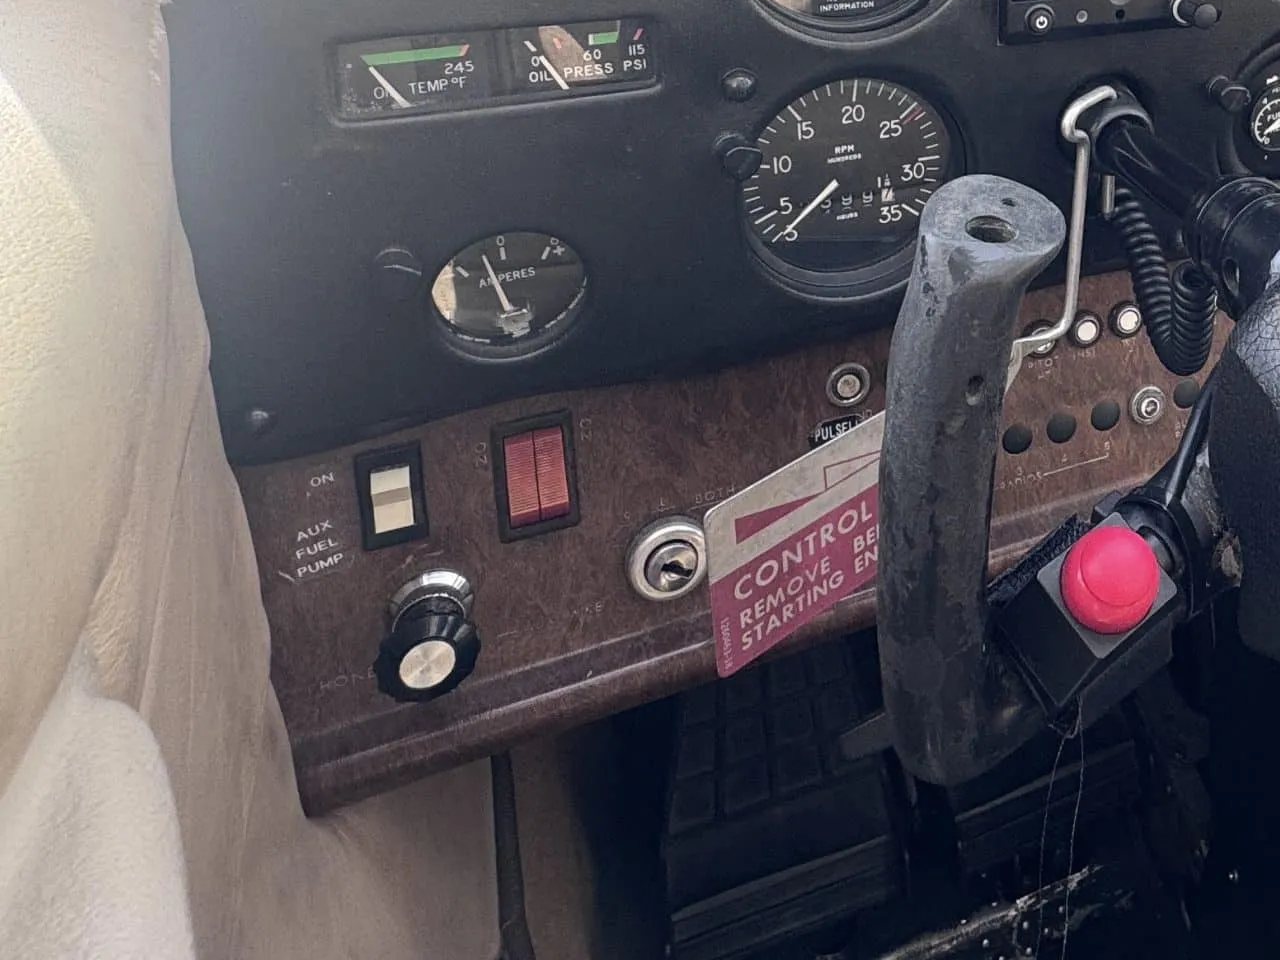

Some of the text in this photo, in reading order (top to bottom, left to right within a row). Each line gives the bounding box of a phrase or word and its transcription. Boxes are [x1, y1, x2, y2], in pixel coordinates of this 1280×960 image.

[819, 1, 875, 13] INFORMATION
[583, 48, 601, 61] 60
[628, 44, 646, 56] 115
[444, 63, 474, 76] 245
[528, 57, 647, 83] OIL PRESS PSI
[531, 56, 539, 68] 0
[841, 104, 865, 124] 20
[797, 121, 815, 141] 15
[879, 120, 902, 139] 25
[834, 145, 855, 154] RPM
[773, 155, 792, 175] 10
[901, 163, 925, 181] 30
[780, 197, 793, 215] 5
[879, 204, 902, 223] 35
[310, 472, 334, 487] ON
[296, 519, 333, 542] AUX
[295, 537, 339, 560] FUEL
[734, 500, 872, 600] CONTROL
[296, 552, 344, 578] PUMP
[739, 556, 830, 629] REMOVE
[742, 570, 845, 650] STARTING
